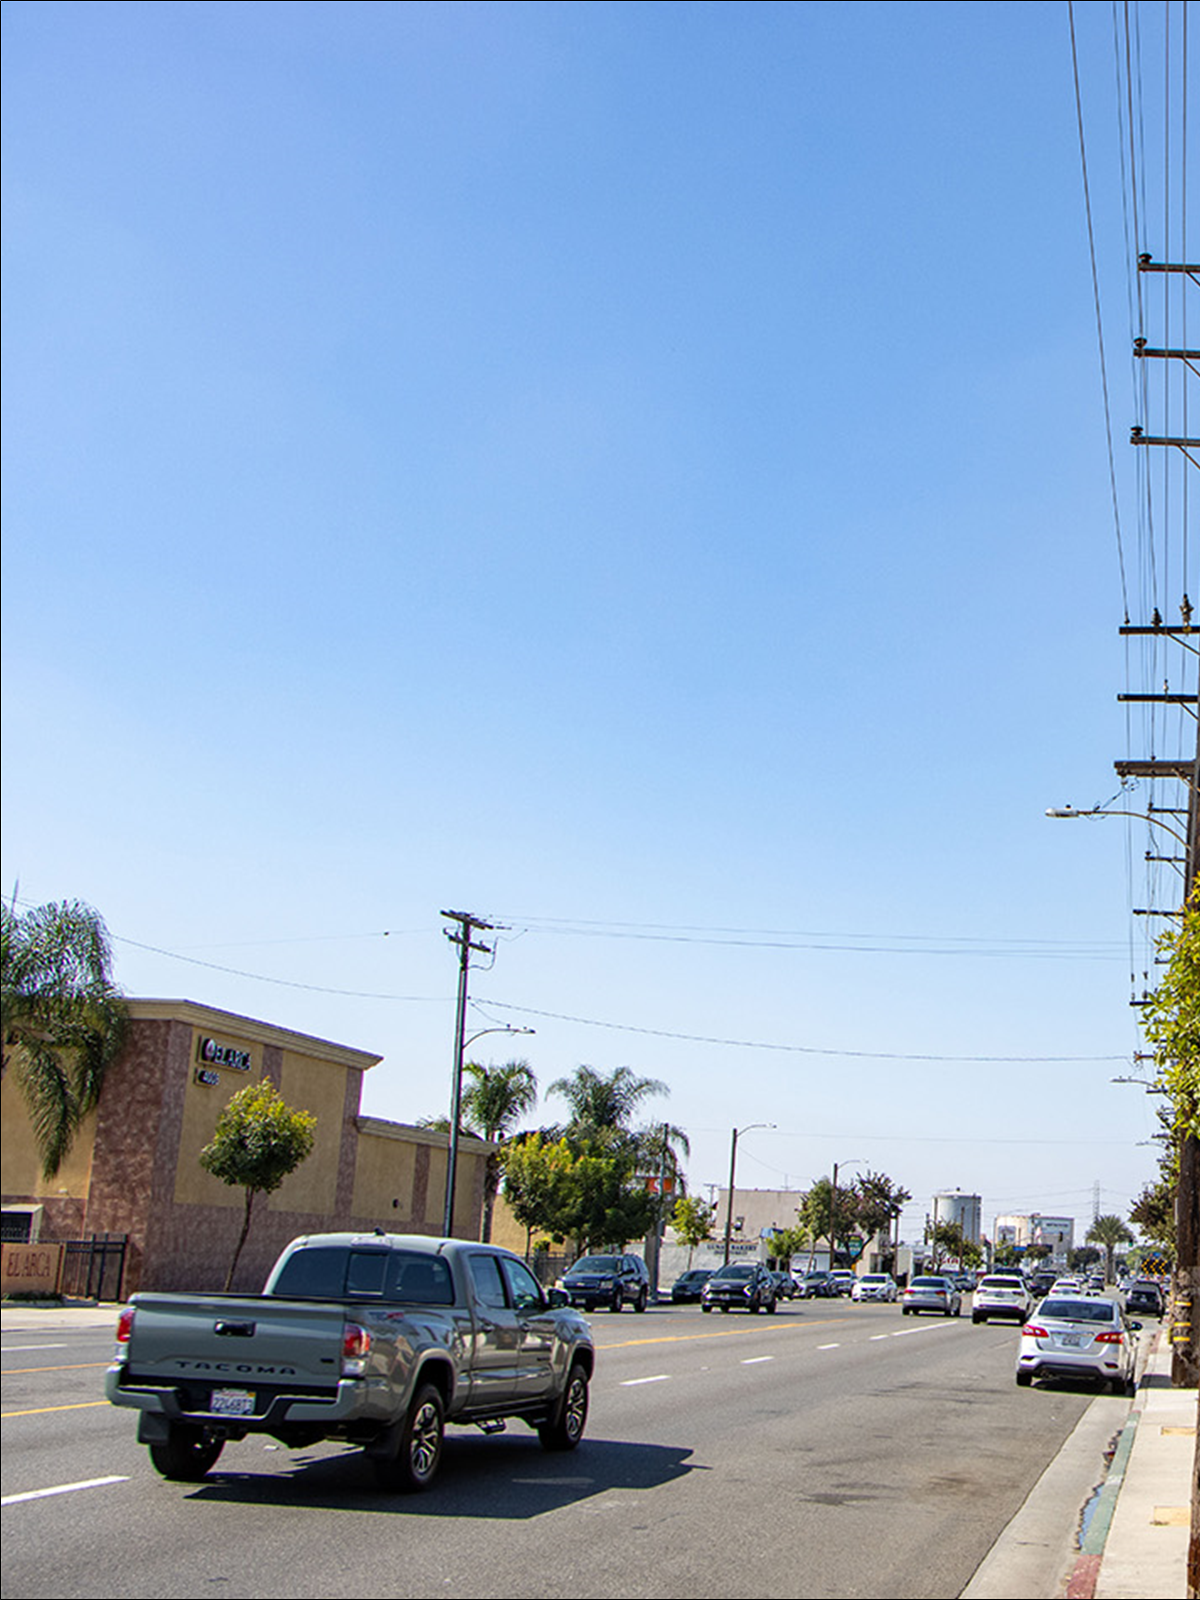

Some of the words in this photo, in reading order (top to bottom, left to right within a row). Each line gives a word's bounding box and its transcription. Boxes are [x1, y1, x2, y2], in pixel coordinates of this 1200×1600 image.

[7, 1252, 20, 1277] EL
[21, 1251, 50, 1277] ARCA
[175, 1361, 296, 1375] TACOMA
